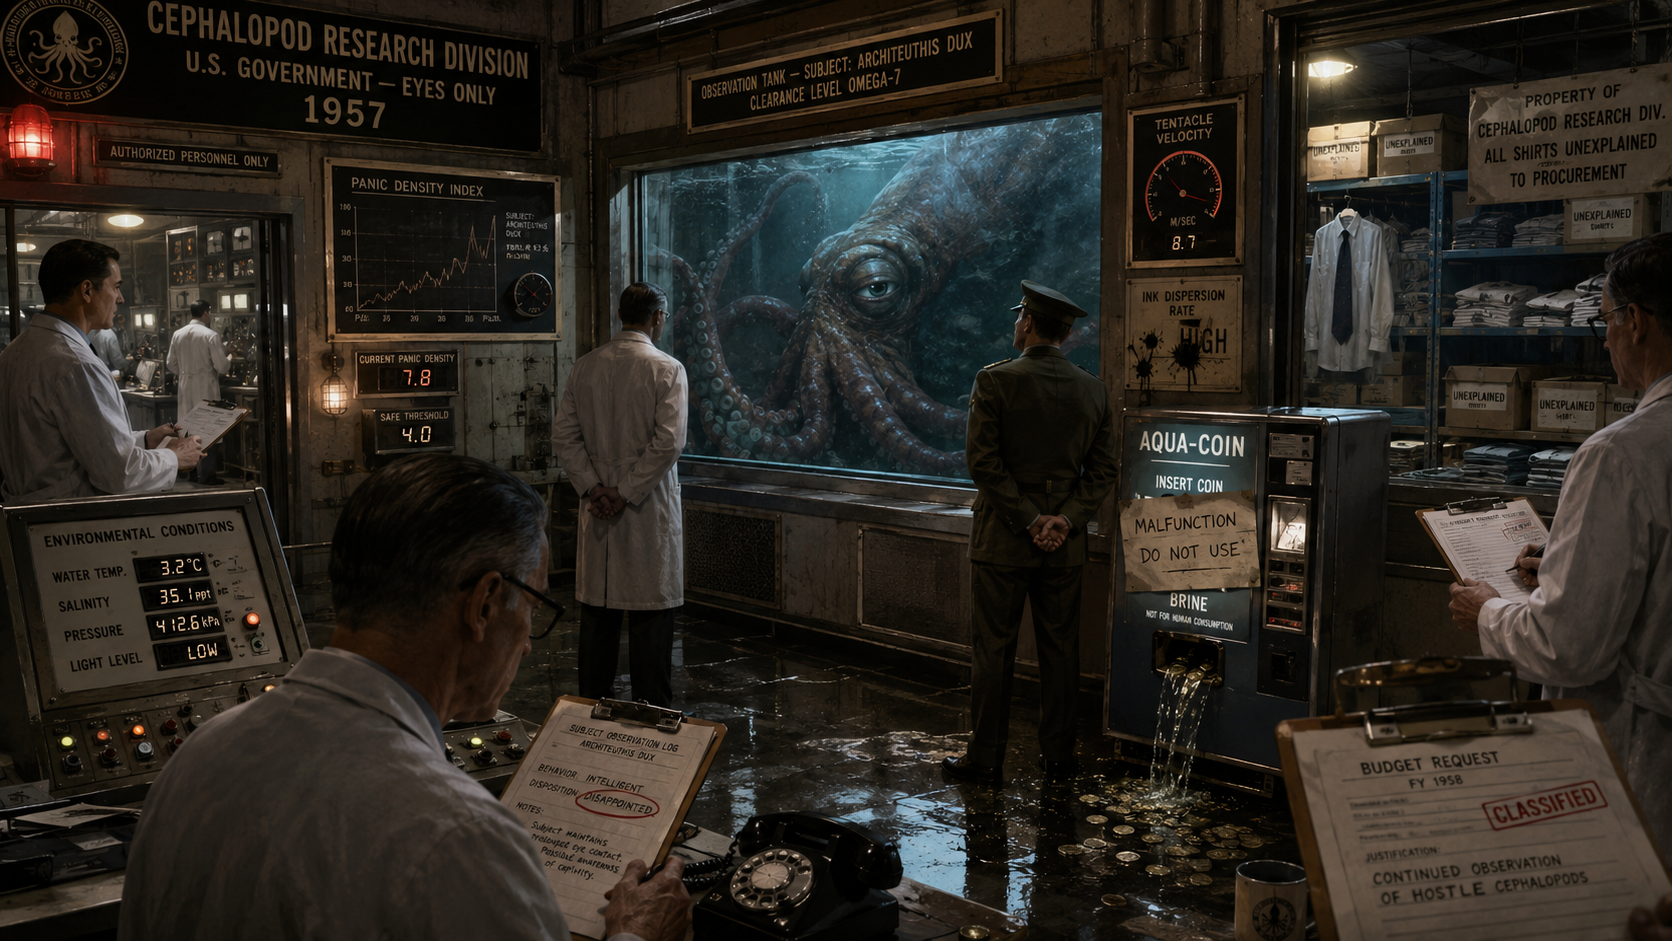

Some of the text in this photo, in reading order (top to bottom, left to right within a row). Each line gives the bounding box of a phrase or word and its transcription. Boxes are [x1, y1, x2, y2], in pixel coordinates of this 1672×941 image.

[147, 1, 312, 52] CEPHALOPOD
[323, 23, 435, 68] RESEARCH
[444, 40, 529, 80] DIVISION
[700, 76, 758, 100] OBSERVATION
[762, 69, 786, 90] TANK
[804, 56, 852, 80] SUBJECT:
[857, 38, 940, 70] ARCHITEUTHIS
[946, 31, 974, 53] DUX
[185, 50, 228, 76] U.S.
[236, 55, 374, 92] GOVERNMENT
[402, 76, 446, 101] EYES
[453, 81, 497, 107] ONLY
[749, 68, 902, 112] CLEARANCE LEVEL OMEGA-7
[1525, 83, 1622, 108] PROPERTY OF
[304, 94, 387, 129] 1957
[1154, 112, 1215, 131] TENTACLE
[1478, 103, 1667, 139] CEPHALOPOD RESEARCH DIV.
[1156, 127, 1214, 145] VELOCITY
[110, 145, 270, 168] AUTHORIZED PERSONNEL ONLY
[1484, 132, 1657, 164] ALL SHIRTS UNEXPLAINED
[1510, 163, 1628, 188] TO PROCUREMENT
[351, 176, 484, 197] PANIC DENSITY INDEX
[1170, 215, 1197, 227] M/SEC
[1573, 208, 1632, 222] UNEXPLAINED
[1171, 234, 1197, 251] 8.7
[1142, 289, 1226, 302] INK DISPERSION
[1169, 305, 1195, 316] RATE
[1180, 328, 1227, 354] HIGH
[359, 353, 456, 364] CURRENT PANIC DENSITY
[402, 369, 431, 387] 7.8
[1453, 390, 1505, 404] UNEXPLAINED
[1539, 399, 1595, 412] UNEXPLAINED
[380, 410, 449, 422] SAFE THRESHOLD
[402, 425, 432, 443] 4.0
[1139, 430, 1245, 457] AQUA-COIN
[1155, 474, 1223, 493] INSERT COIN
[44, 520, 235, 548] ENVIRONMENTAL CONDITIONS
[1135, 512, 1237, 535] MALFUNCTION
[1140, 547, 1161, 564] DO
[1170, 544, 1200, 561] NOT
[52, 565, 127, 584] WATER TEMP.
[58, 596, 111, 613] SALINITY
[1170, 592, 1208, 613] BRINE
[1145, 610, 1235, 632] NOT FOR HUMAN CONSUMPTION
[64, 624, 125, 643] PRESSURE
[187, 642, 219, 661] LOW
[69, 652, 143, 673] LIGHT LEVEL
[569, 723, 679, 753] SUBJECT OBSERVATION LOG
[637, 749, 656, 762] DUX
[1361, 751, 1499, 776] BUDGET REQUEST
[585, 774, 644, 794] INTELLIGENT
[1409, 774, 1463, 789] FY 1958
[516, 802, 544, 816] NOTES:
[583, 792, 653, 816] DISAPPOINTED
[1493, 787, 1597, 825] CLASSIFIED
[1373, 854, 1562, 885] CONTINUED OBSERVATION
[1381, 891, 1401, 906] OF
[1495, 871, 1589, 894] CEPHALOPODS
